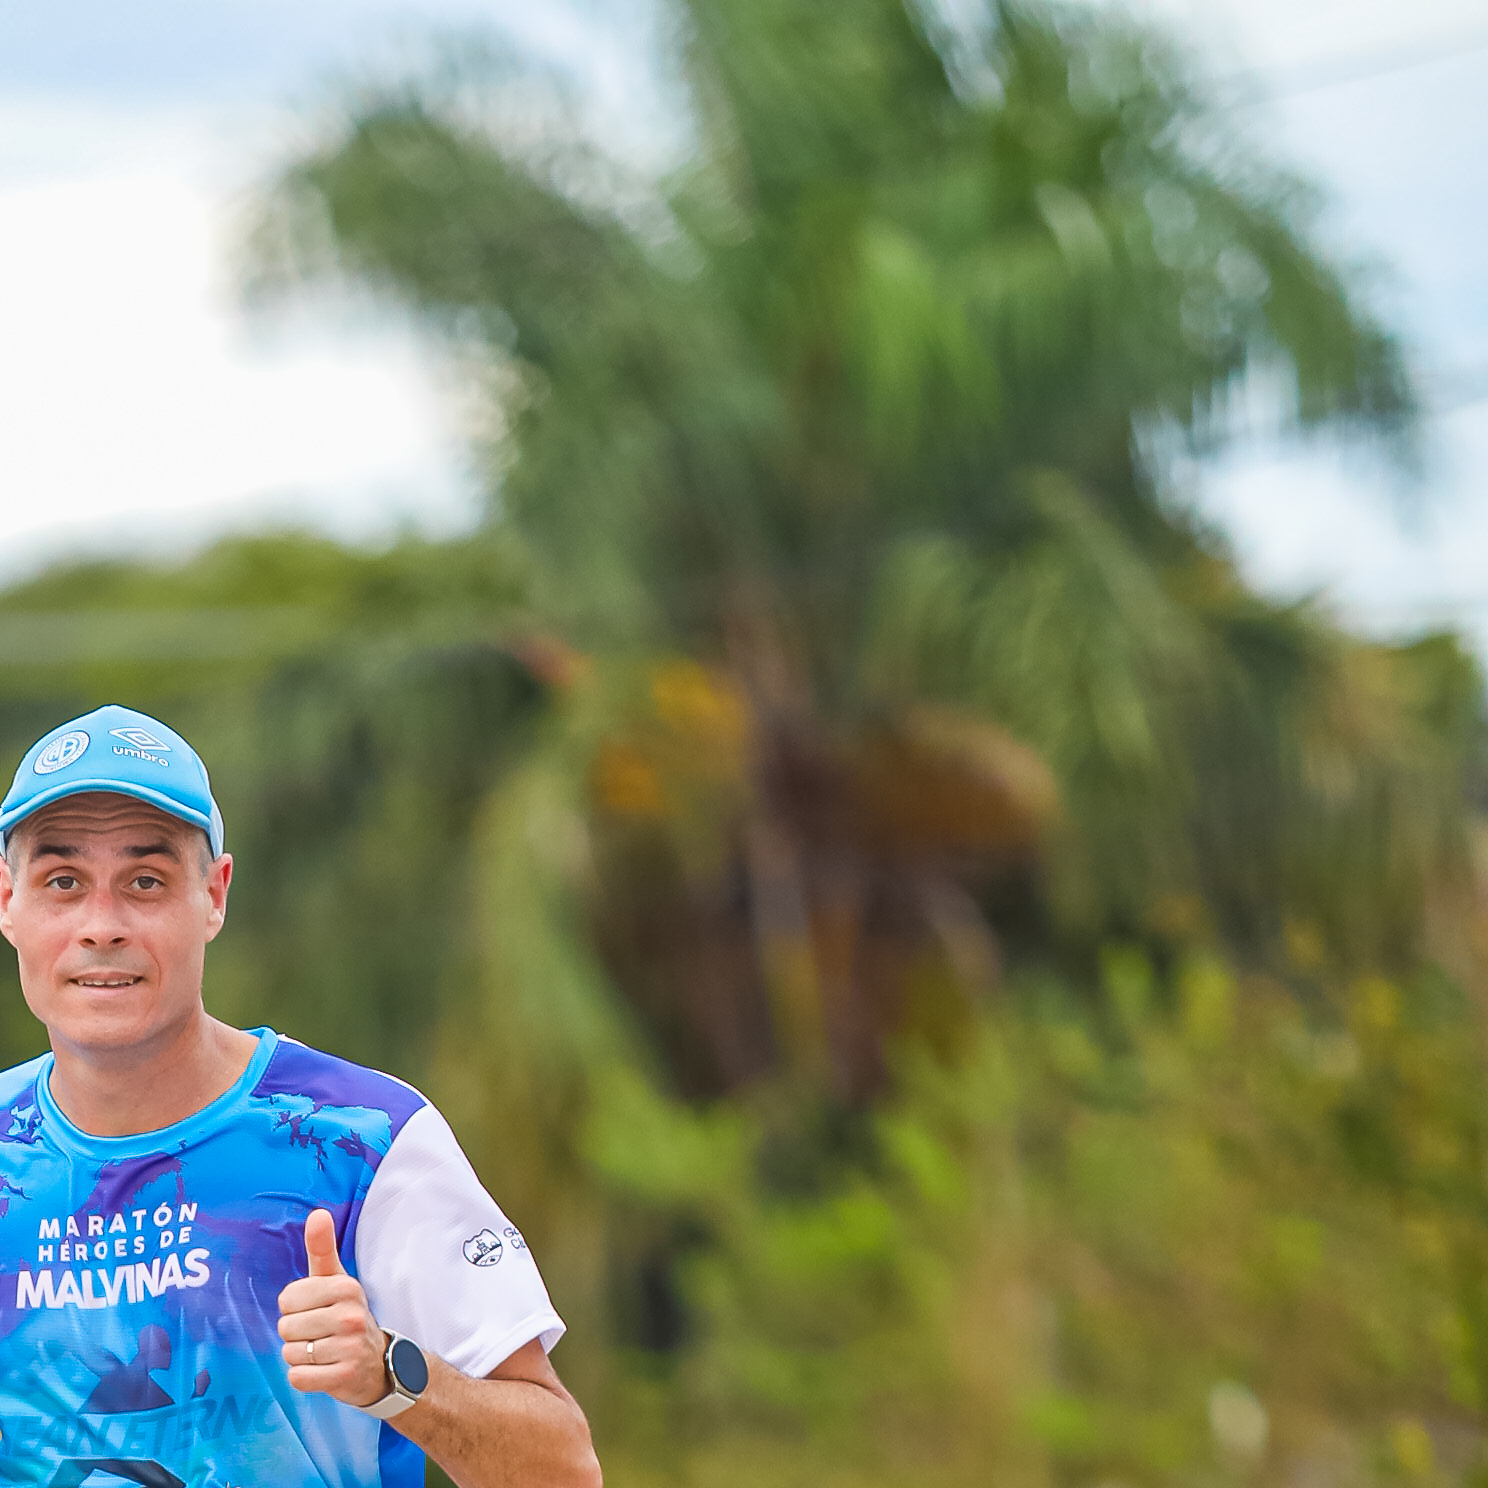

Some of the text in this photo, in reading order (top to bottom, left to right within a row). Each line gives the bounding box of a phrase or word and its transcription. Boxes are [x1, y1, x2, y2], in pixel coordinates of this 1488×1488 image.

[112, 745, 169, 767] umbro
[39, 1202, 198, 1239] MARATÓN
[38, 1226, 192, 1262] HÉROES DE
[16, 1248, 211, 1309] MALVINAS
